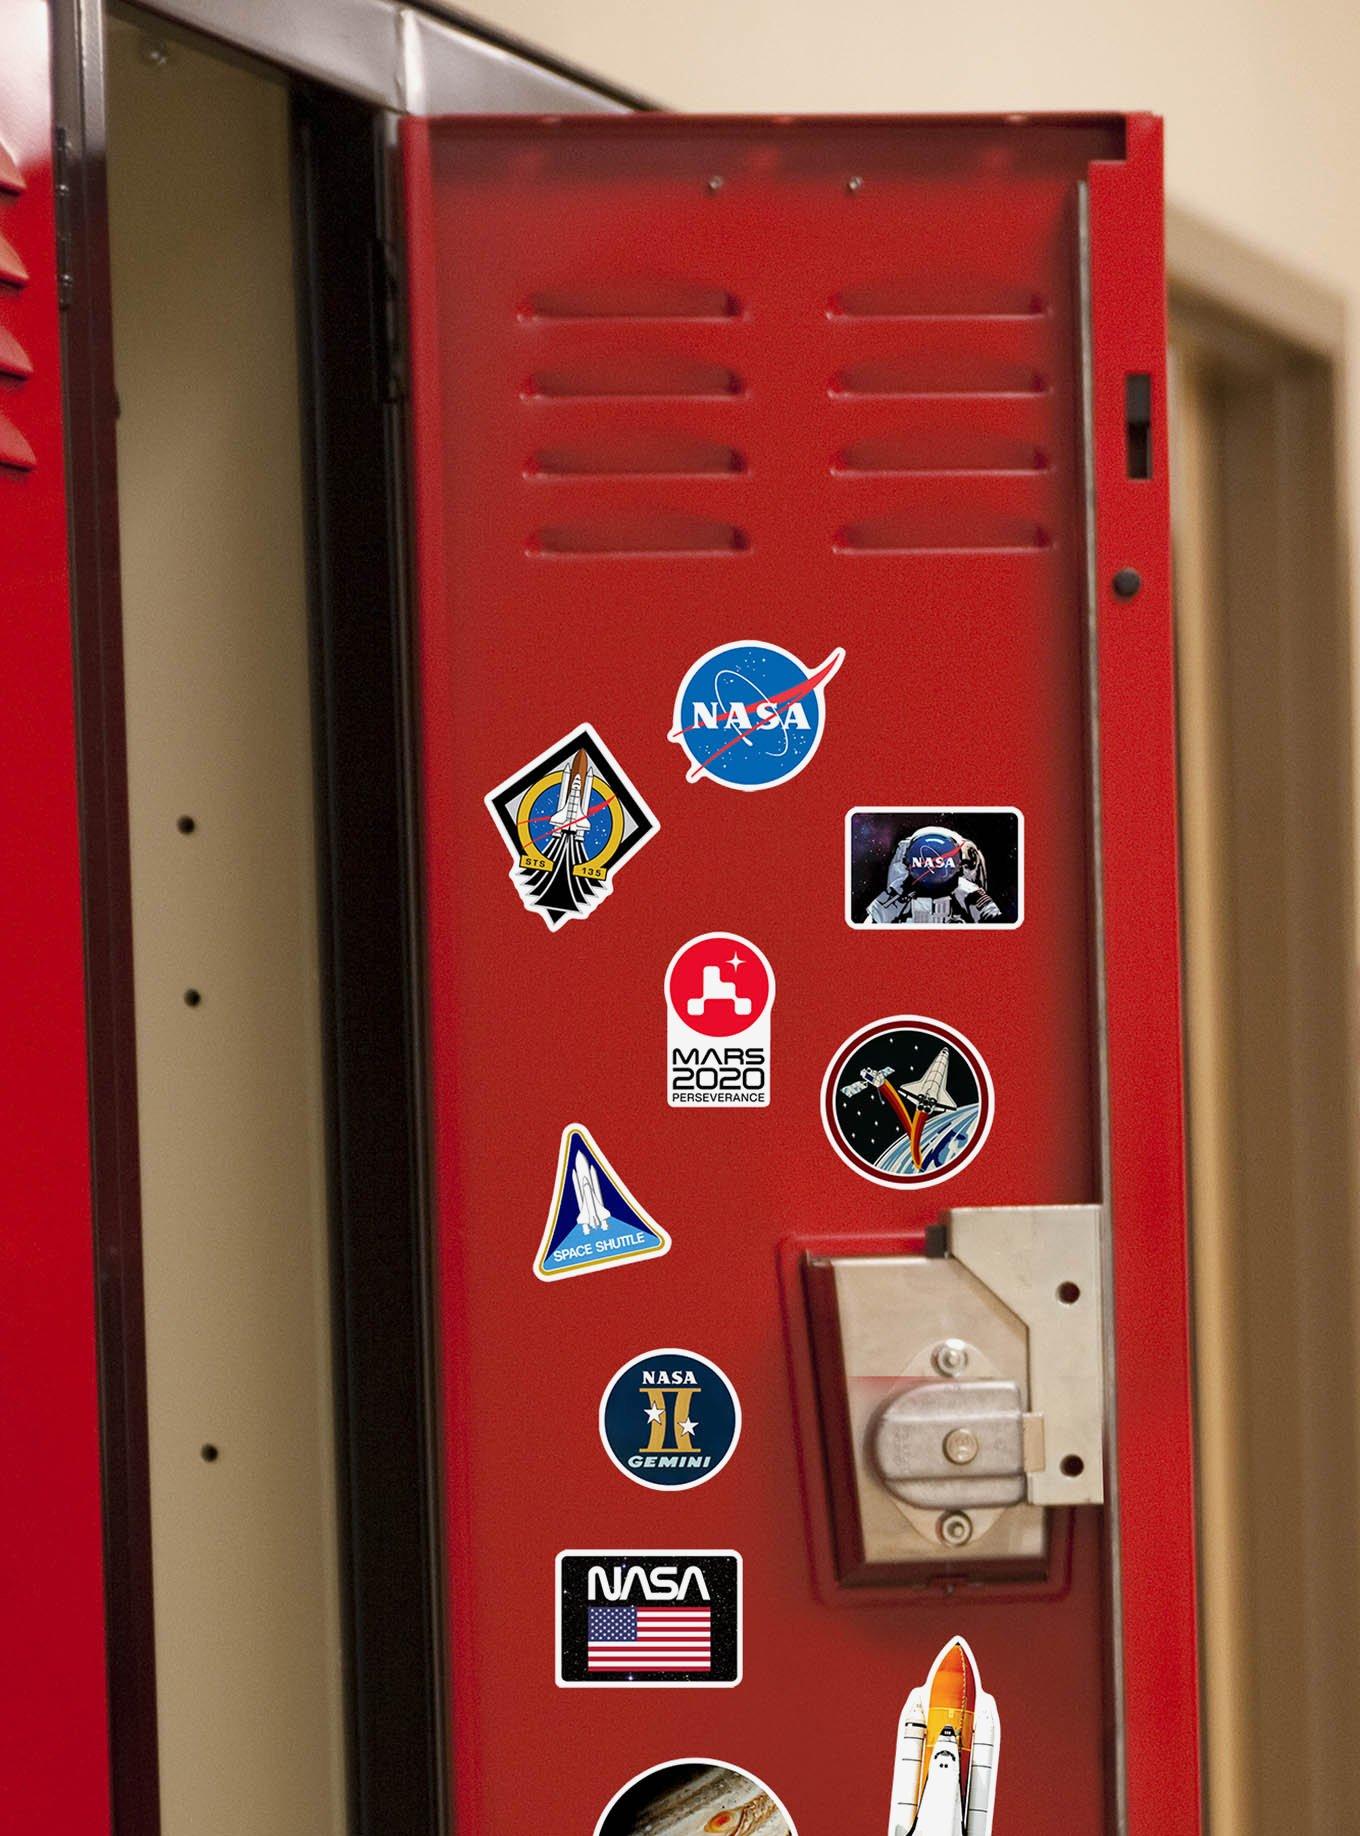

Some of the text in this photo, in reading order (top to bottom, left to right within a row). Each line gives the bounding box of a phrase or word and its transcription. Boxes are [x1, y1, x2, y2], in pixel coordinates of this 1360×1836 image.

[692, 702, 811, 730] NASA
[525, 857, 602, 877] STS 135
[912, 856, 956, 868] NASA
[672, 1048, 765, 1065] MARS
[672, 1067, 765, 1090] 2020
[672, 1092, 765, 1102] PERSEVERANCE
[553, 1231, 645, 1262] SPACE SHUTTLE
[642, 1370, 698, 1385] NASA
[628, 1455, 711, 1468] GEMINI
[588, 1565, 711, 1601] NASA
